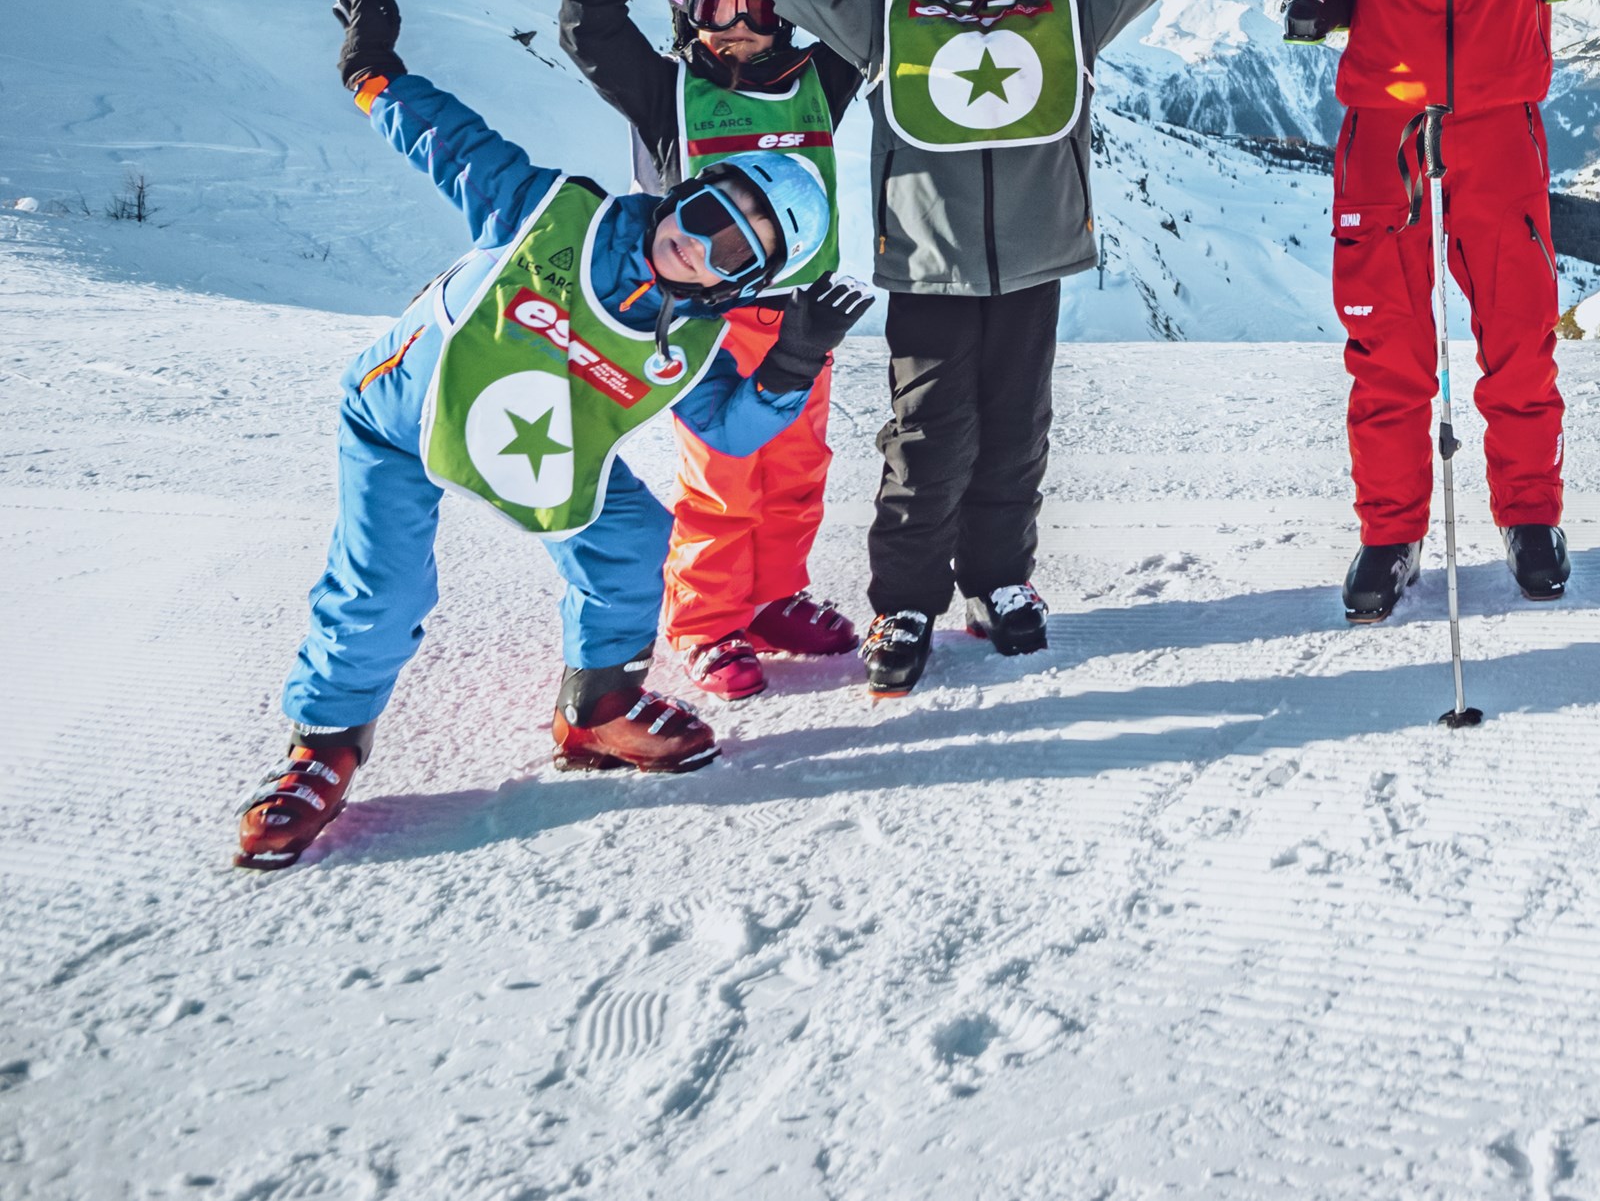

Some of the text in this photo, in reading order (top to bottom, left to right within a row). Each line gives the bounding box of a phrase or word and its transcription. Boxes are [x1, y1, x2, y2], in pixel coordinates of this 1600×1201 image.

[694, 120, 715, 131] LES
[718, 117, 753, 129] ARCS
[516, 257, 543, 276] LES
